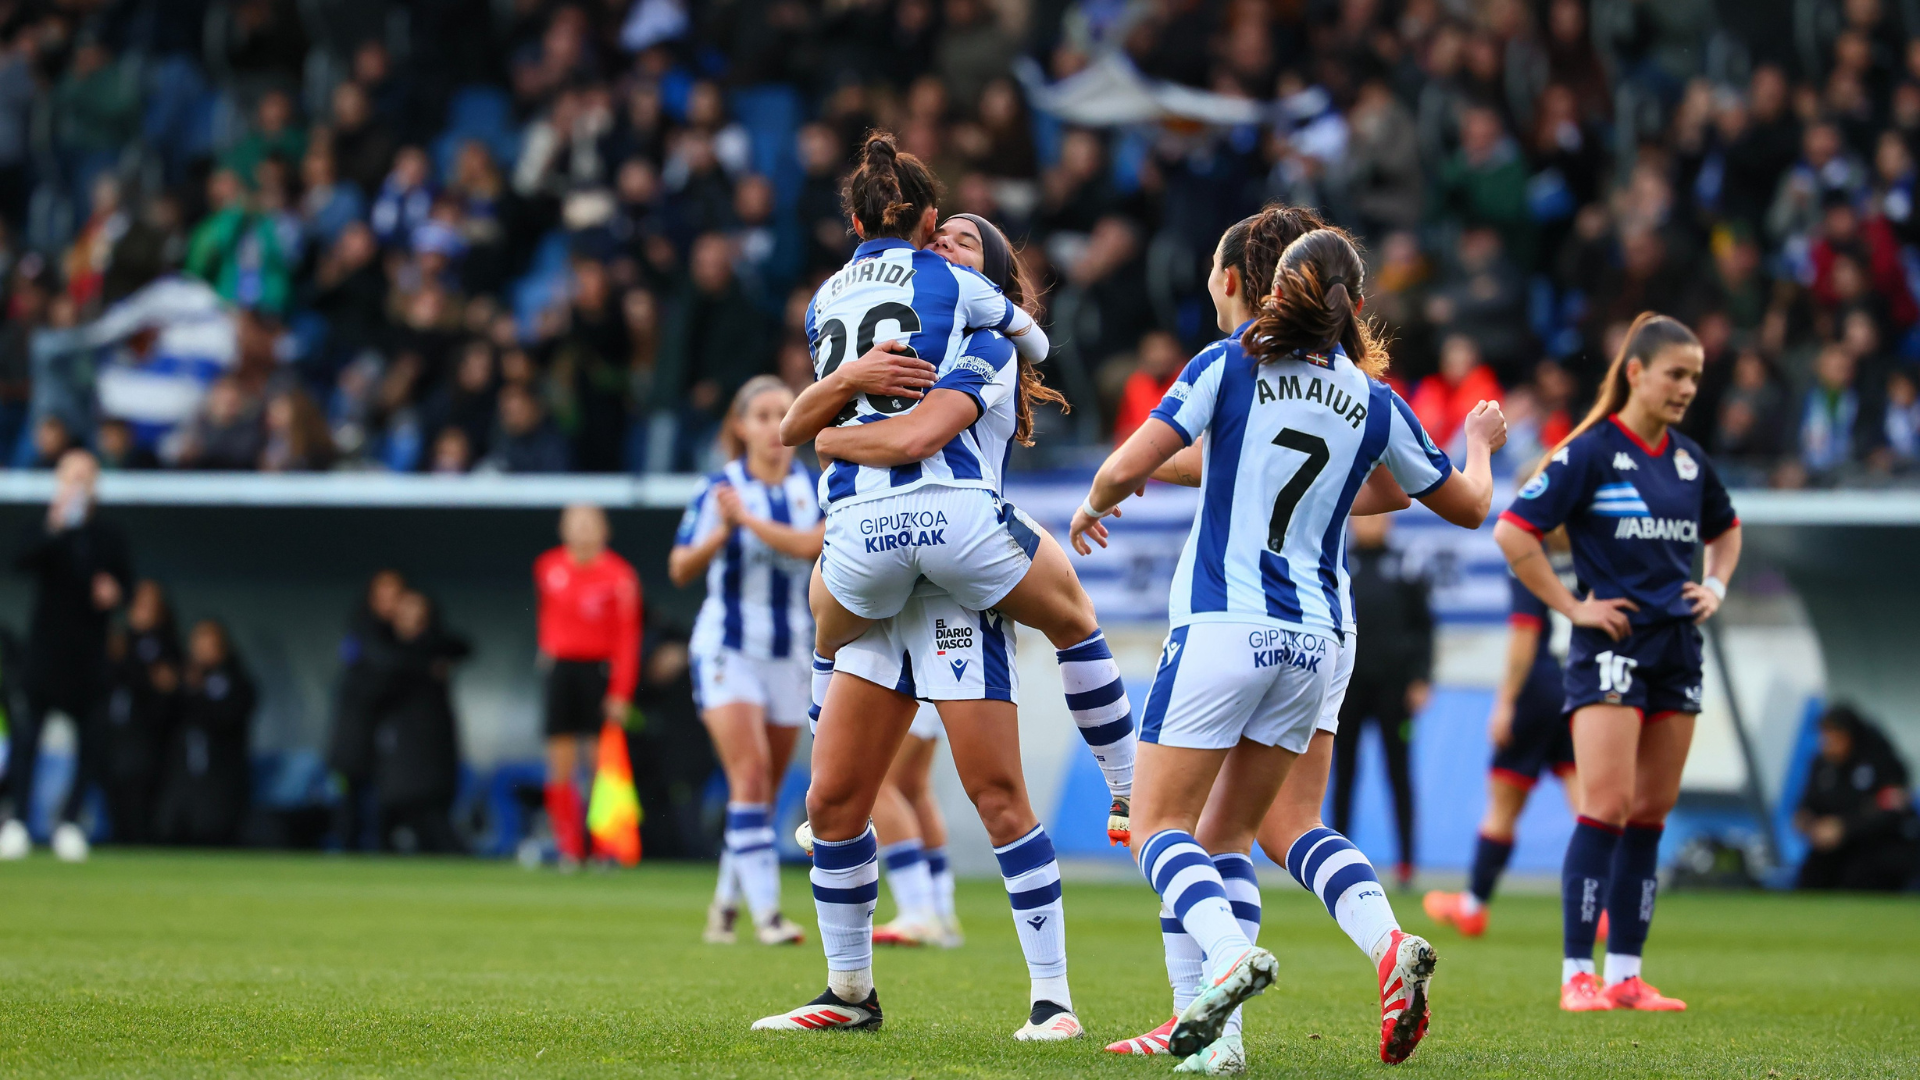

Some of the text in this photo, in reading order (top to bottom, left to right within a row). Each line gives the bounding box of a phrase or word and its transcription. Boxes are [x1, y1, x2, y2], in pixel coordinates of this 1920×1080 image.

[831, 262, 917, 296] GURIDI
[1257, 375, 1368, 430] AMAIUR
[1268, 427, 1330, 554] 7
[860, 510, 949, 535] GIPUZKOA
[865, 528, 947, 554] KIROLAK
[935, 618, 948, 629] EL
[935, 626, 973, 640] DIARIO
[936, 637, 973, 650] VASCO
